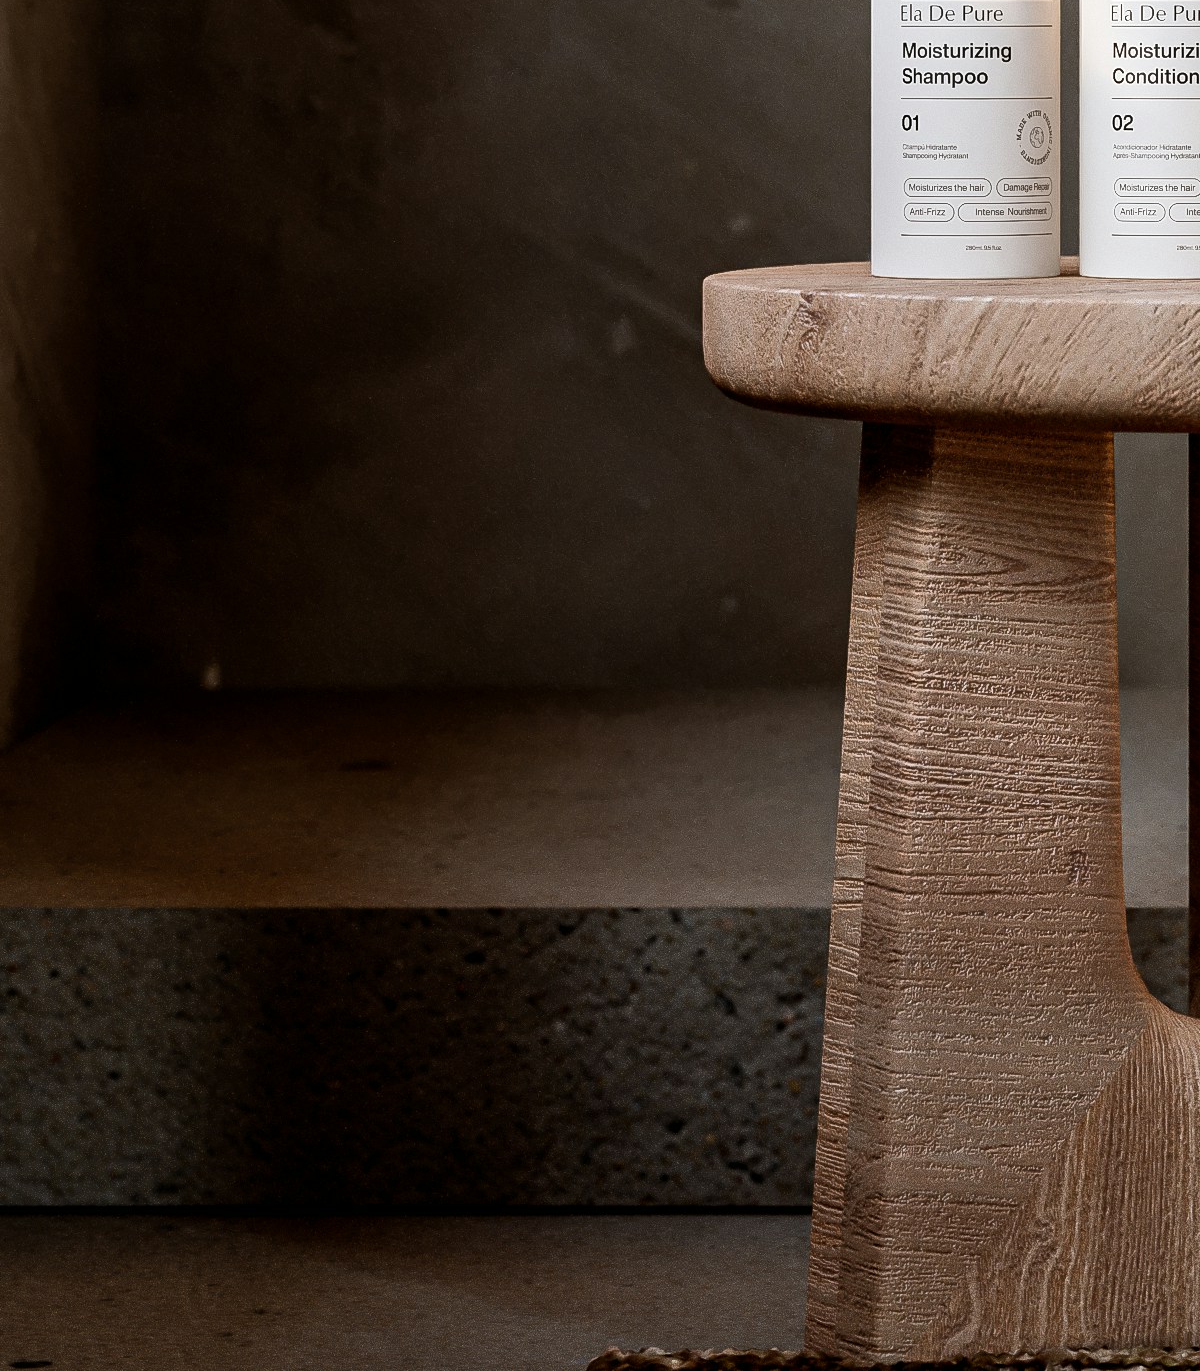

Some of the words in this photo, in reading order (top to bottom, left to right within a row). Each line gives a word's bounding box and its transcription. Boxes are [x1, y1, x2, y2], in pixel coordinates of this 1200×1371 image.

[901, 4, 922, 22] Ela
[930, 4, 956, 22] De
[962, 4, 1003, 22] Pure
[1111, 4, 1133, 22] Ela
[1140, 4, 1167, 22] De
[902, 42, 1012, 62] Moisturizing
[902, 68, 988, 88] Shampoo
[902, 115, 919, 132] 01
[1112, 115, 1134, 132] 02
[908, 183, 952, 192] Moisturizes
[954, 183, 967, 192] the
[969, 183, 985, 192] hair
[1003, 183, 1032, 194] Damage
[1119, 183, 1163, 192] Moisturizes
[1165, 183, 1178, 192] the
[1180, 183, 1196, 192] hair
[909, 207, 946, 216] Anti-Frizz
[975, 207, 1004, 216] Intense
[1007, 207, 1047, 216] Nourishment
[1120, 207, 1157, 216] Anti-Frizz
